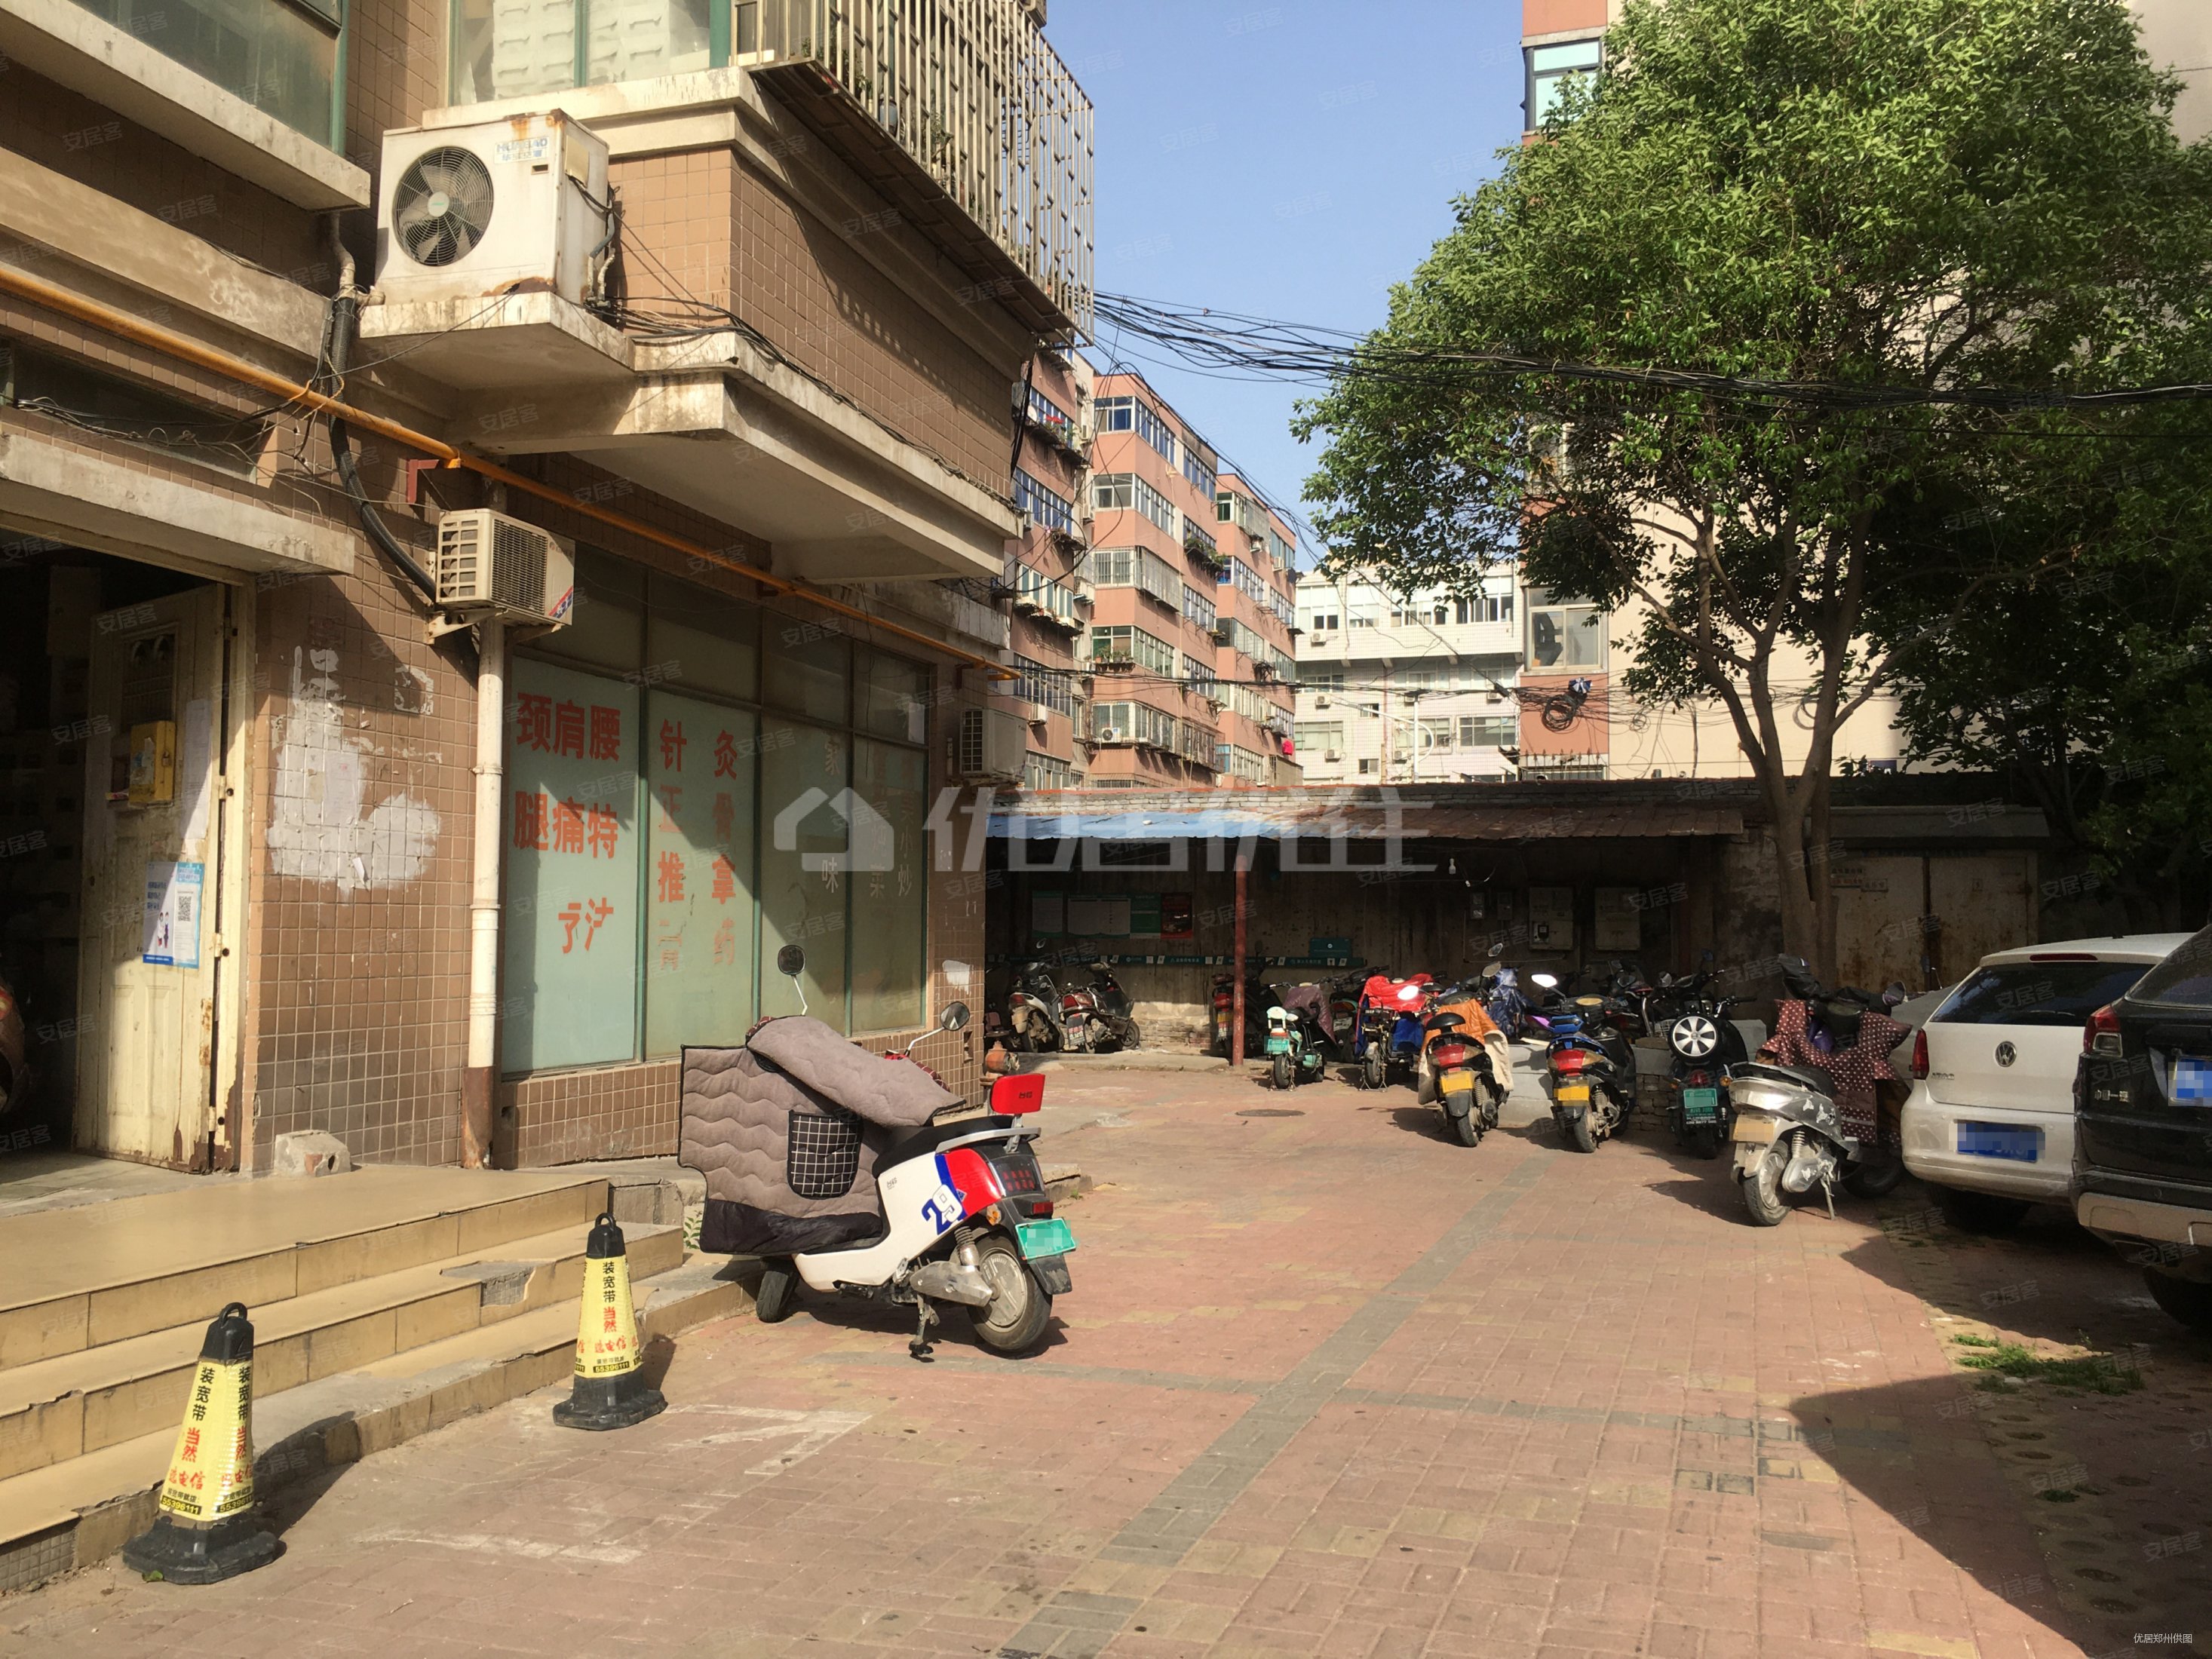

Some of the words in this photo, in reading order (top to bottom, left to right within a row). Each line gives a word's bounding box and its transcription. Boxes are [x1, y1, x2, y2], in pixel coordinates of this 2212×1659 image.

[517, 692, 621, 762] 颈肩腰
[514, 790, 619, 860] 腿痛特
[922, 1184, 962, 1235] 29
[594, 1361, 630, 1372] 55396111
[161, 1496, 200, 1514] 55396111
